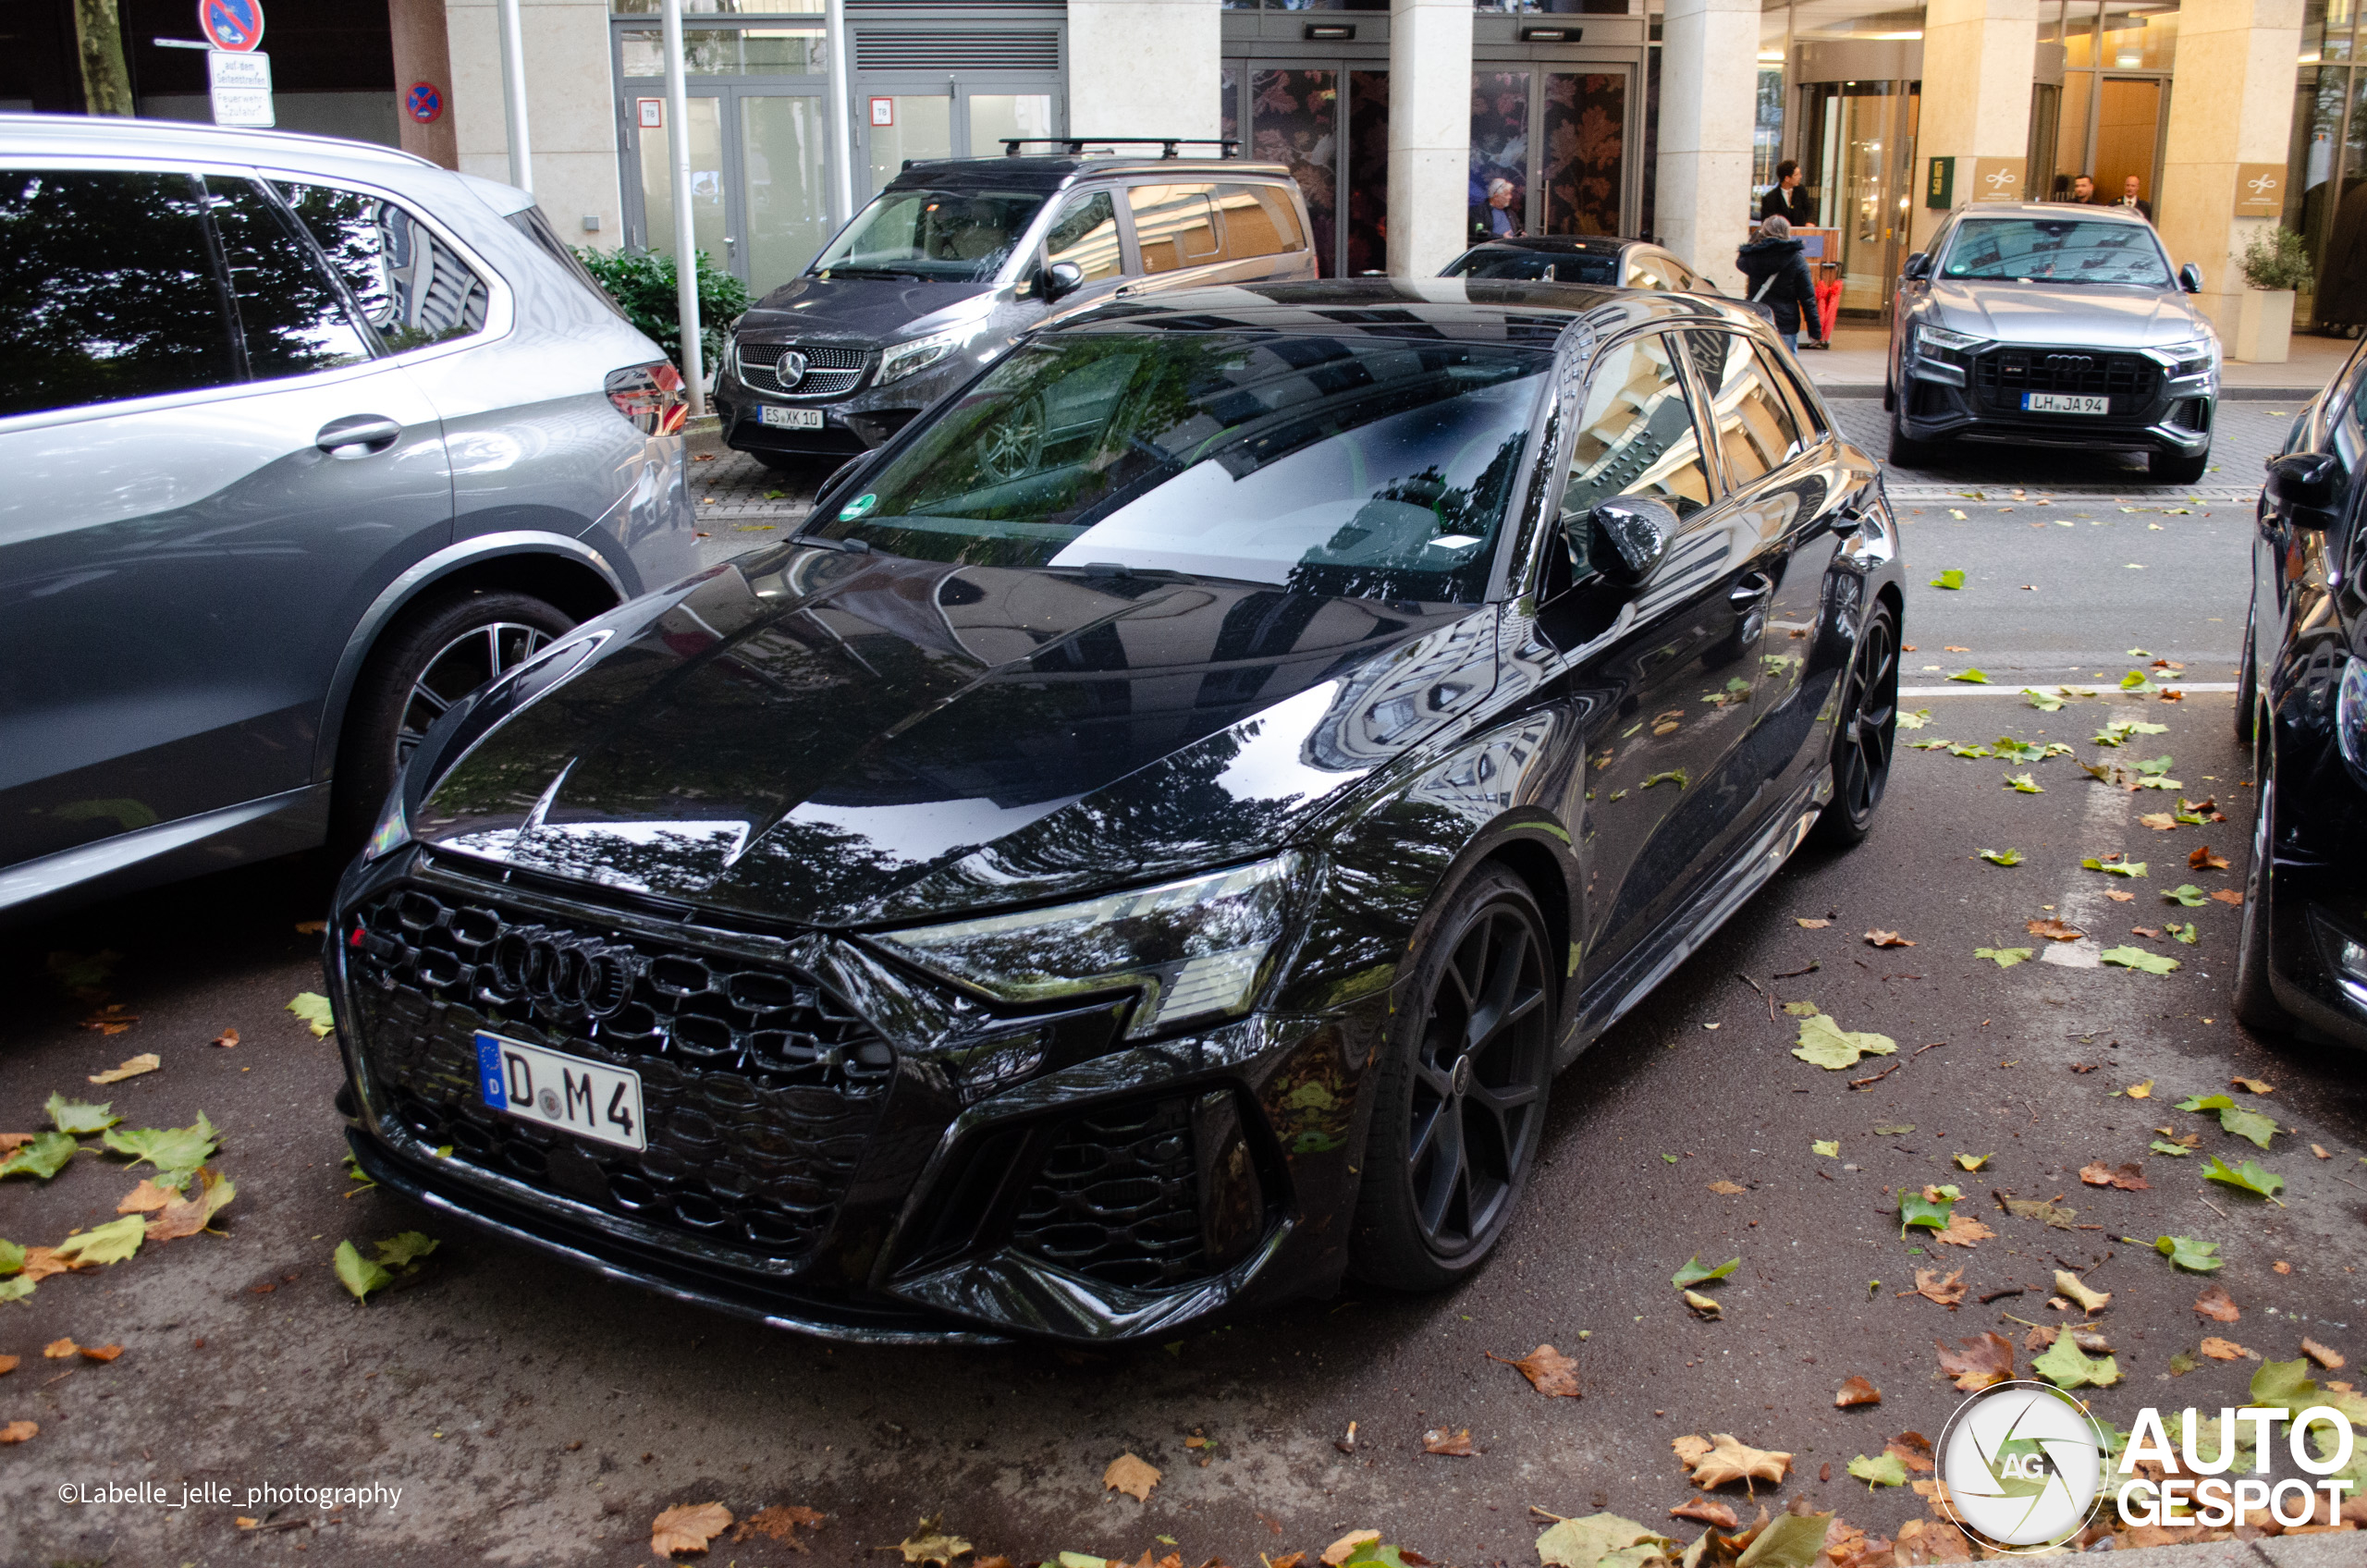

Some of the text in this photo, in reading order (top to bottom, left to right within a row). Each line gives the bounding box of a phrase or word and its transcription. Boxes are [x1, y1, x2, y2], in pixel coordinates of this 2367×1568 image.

[2034, 396, 2054, 410] LH
[2062, 398, 2080, 410] JA
[2085, 398, 2102, 411] 94
[766, 409, 779, 423] ES
[786, 410, 800, 424] XK
[803, 412, 817, 425] 10
[489, 1078, 499, 1095] D
[504, 1050, 533, 1108] D
